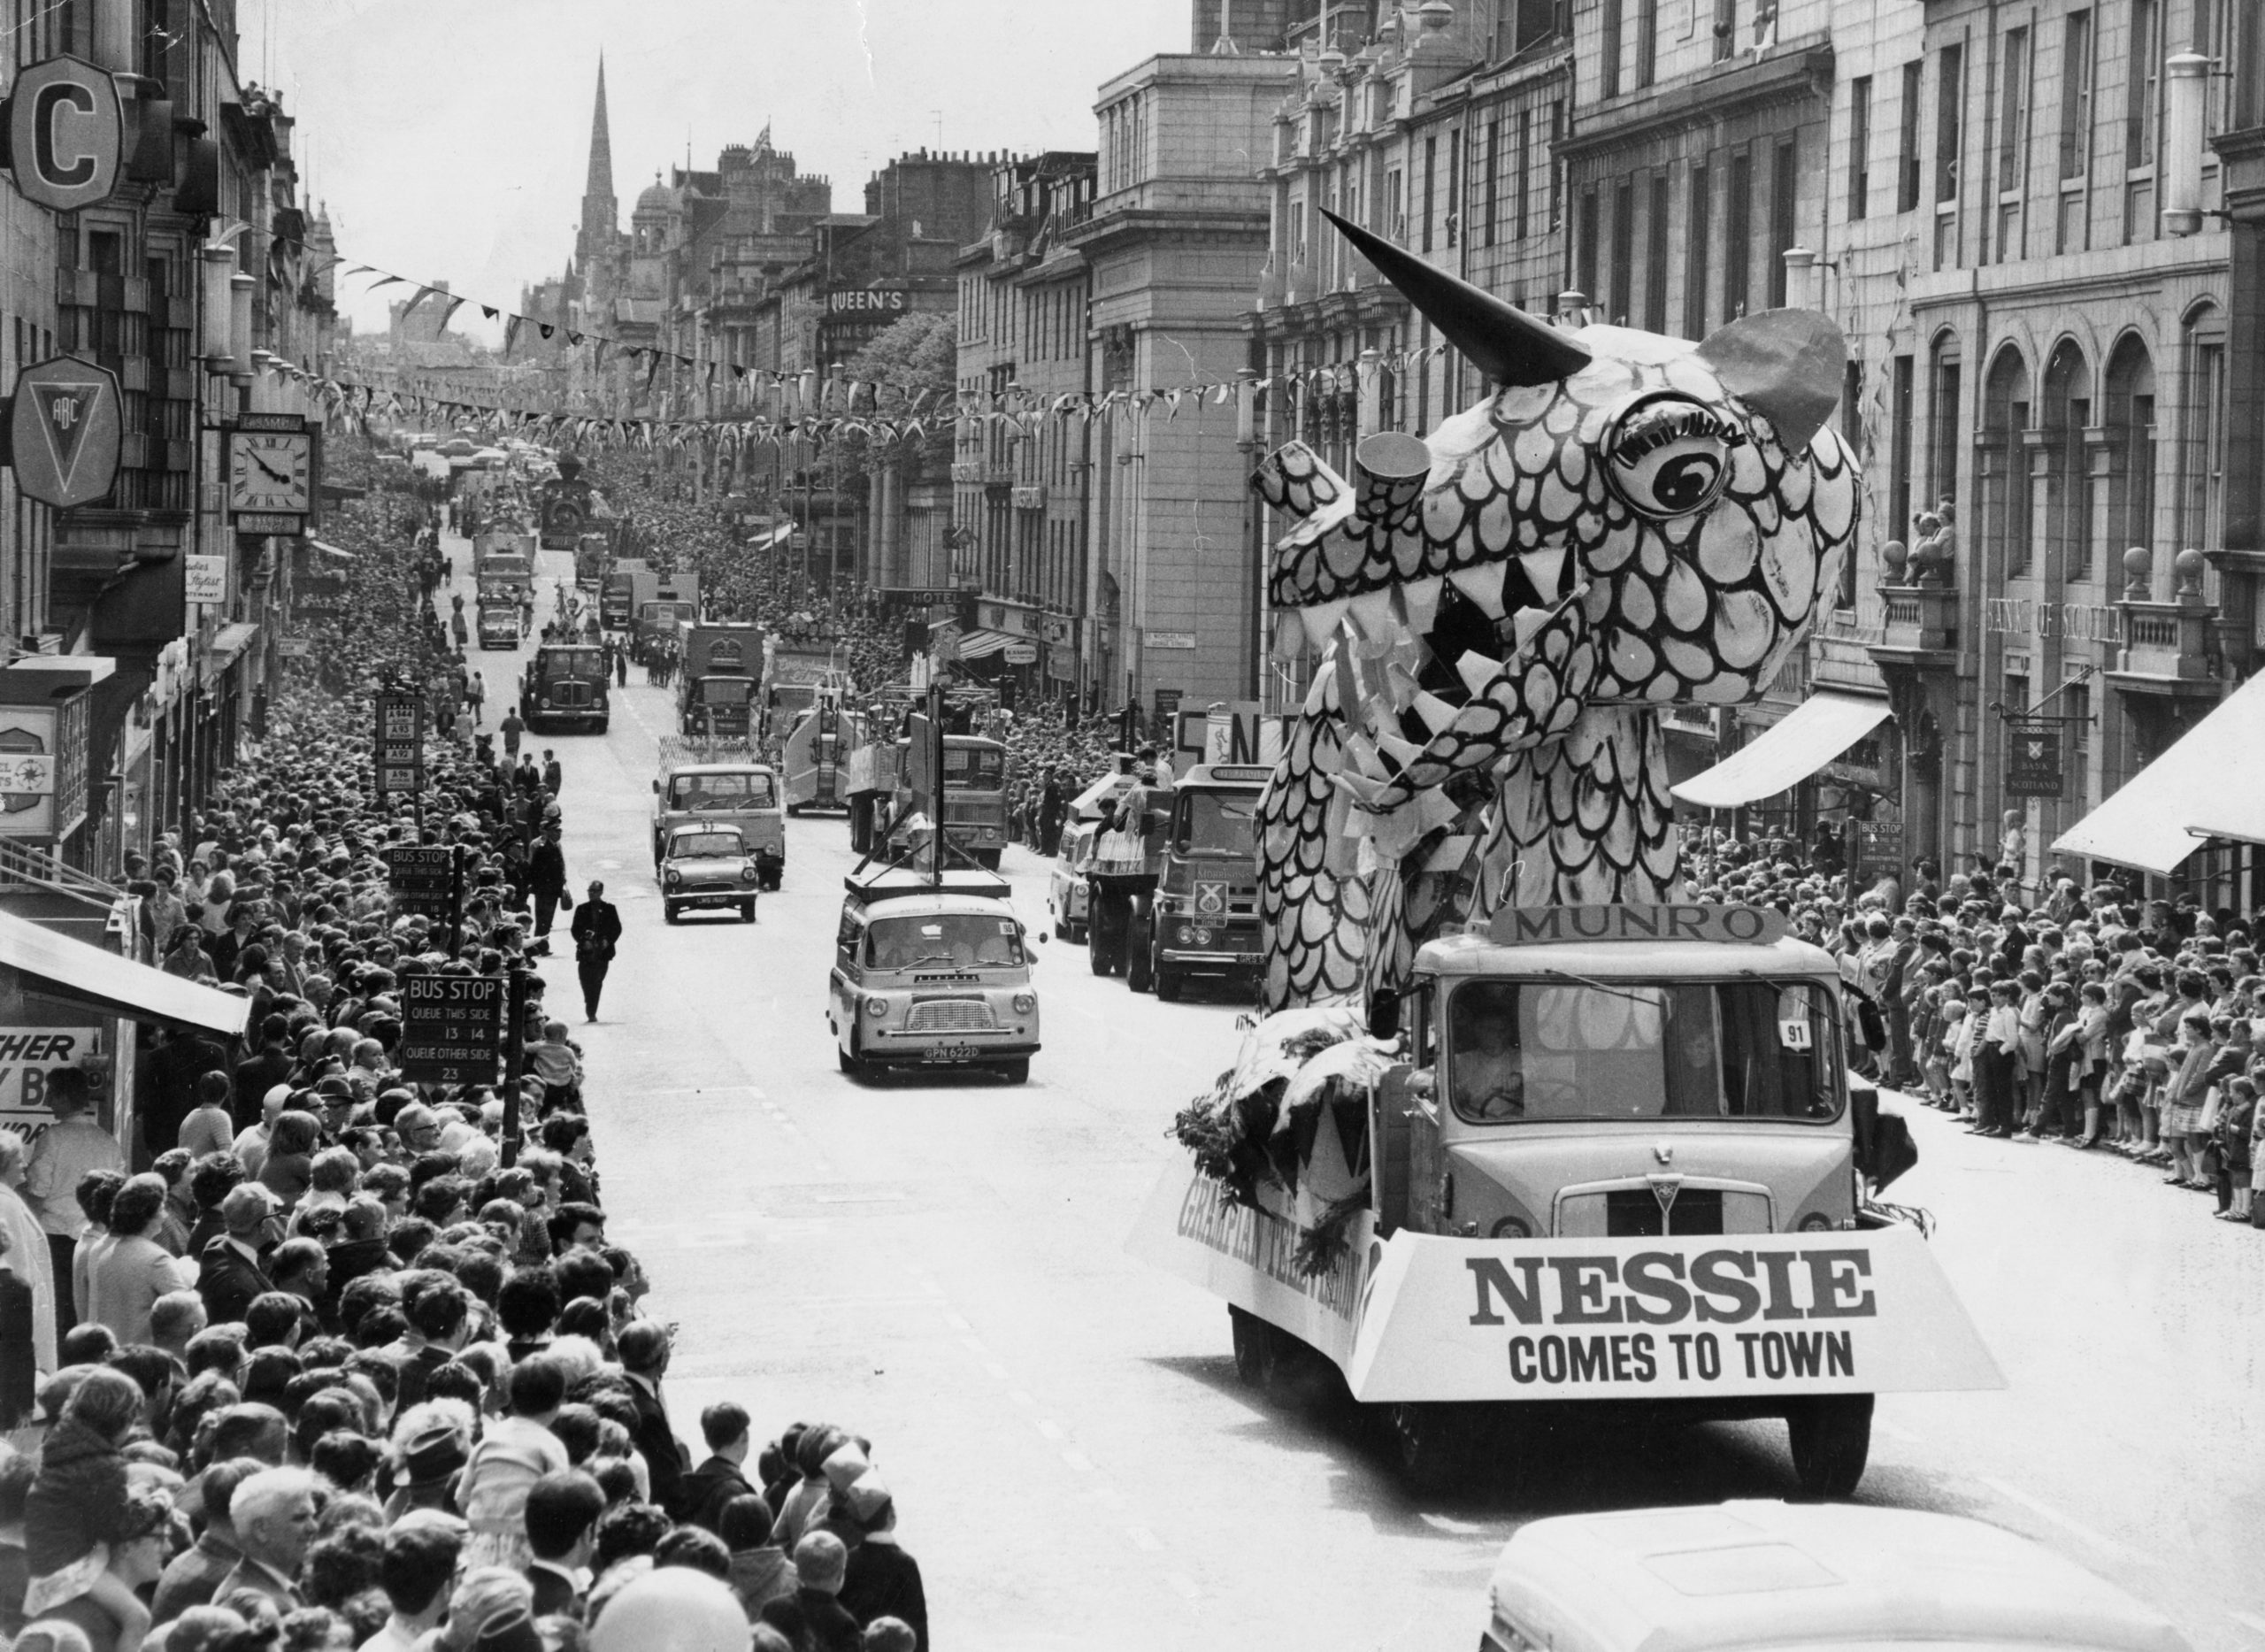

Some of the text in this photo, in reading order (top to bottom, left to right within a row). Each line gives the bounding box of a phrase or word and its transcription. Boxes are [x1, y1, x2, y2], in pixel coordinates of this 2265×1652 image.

[32, 81, 97, 188] C
[832, 291, 902, 313] QUEEN'S
[53, 397, 79, 429] ABC
[186, 561, 209, 571] adies
[187, 572, 222, 590] Stylist
[913, 593, 961, 603] HOTEL
[2022, 762, 2049, 771] BANK
[2011, 780, 2059, 790] SCOTLAND
[1862, 823, 1901, 834] BUS STOP
[393, 849, 446, 864] BUS STOP
[428, 880, 434, 888] 2
[1514, 906, 1764, 941] MUNRO
[410, 980, 495, 1000] BUS STOP
[411, 1007, 490, 1020] QUEUE THIS SIDE
[445, 1027, 485, 1040] 13 14
[1787, 1025, 1804, 1042] 91
[406, 1047, 491, 1060] QUEUE OTHER SIDE
[925, 1048, 979, 1057] GPN 622D
[442, 1067, 458, 1080] 23
[1465, 1249, 1877, 1325] NESSIE
[1509, 1330, 1854, 1384] COMES TO TOWN
